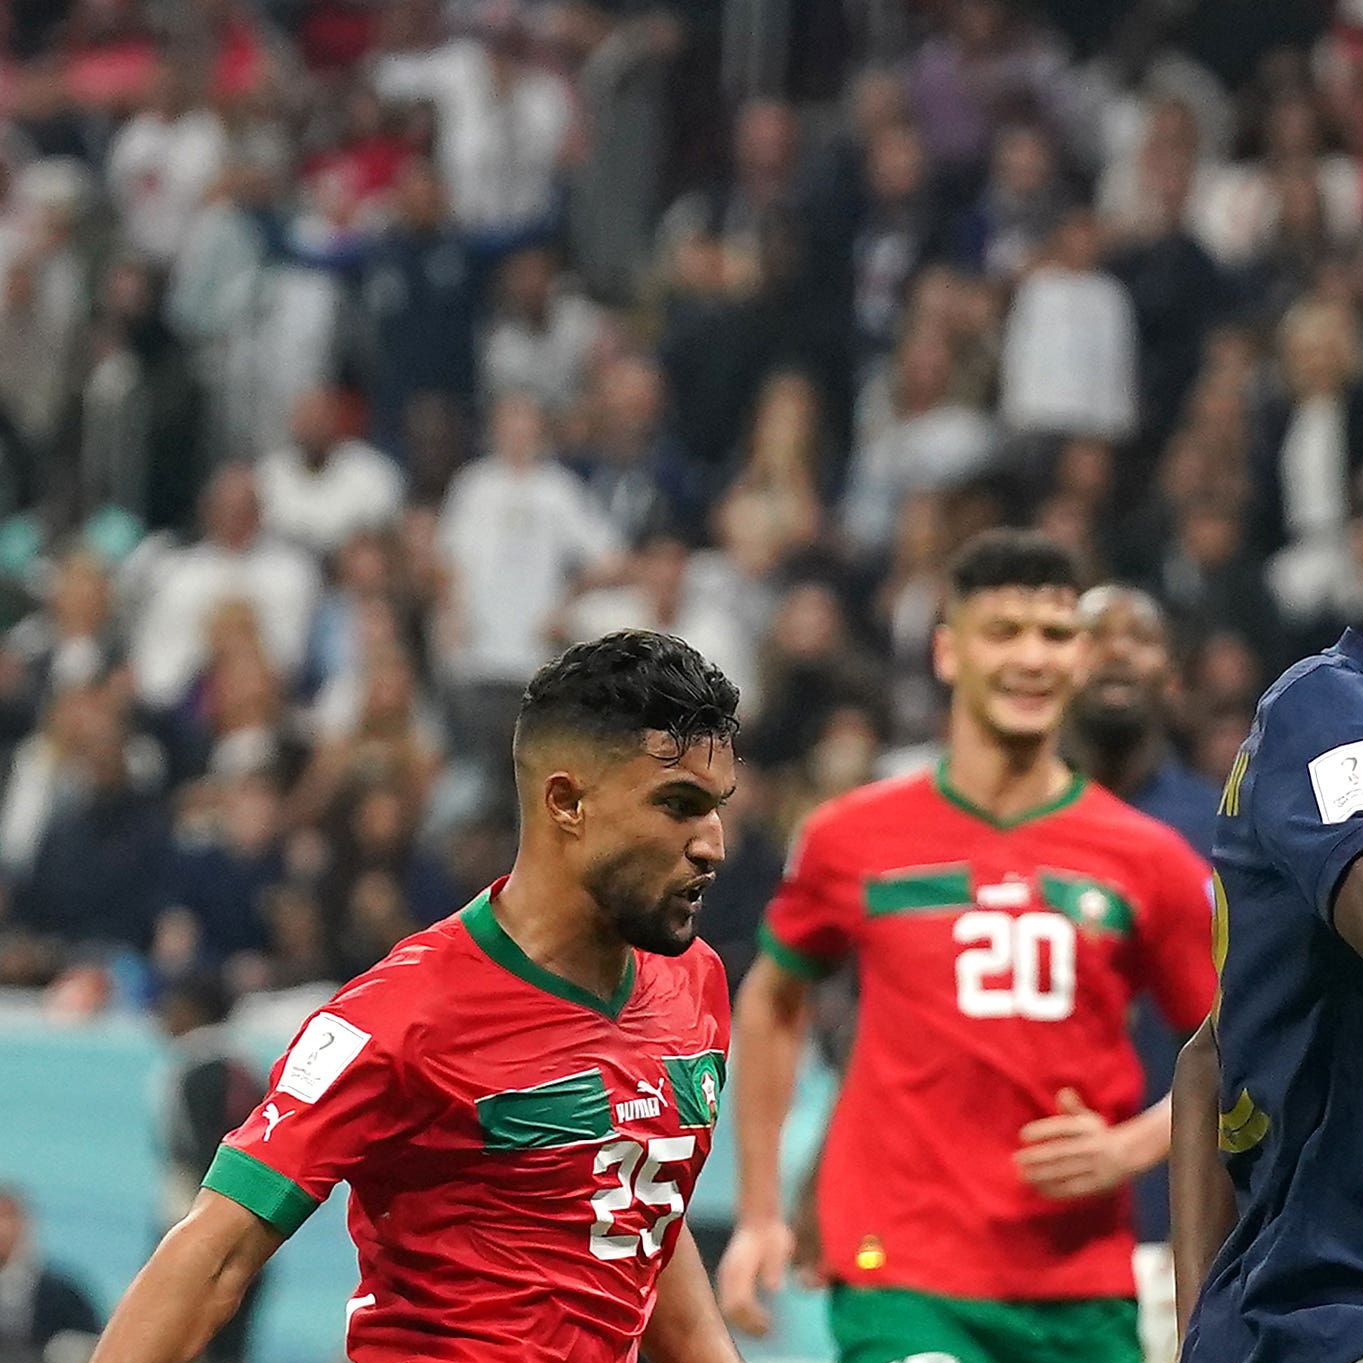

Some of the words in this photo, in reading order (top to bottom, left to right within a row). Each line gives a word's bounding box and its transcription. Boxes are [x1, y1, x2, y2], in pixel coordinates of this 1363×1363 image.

[953, 911, 1077, 1022] 20
[615, 1097, 660, 1123] PUMA
[589, 1135, 696, 1260] 25
